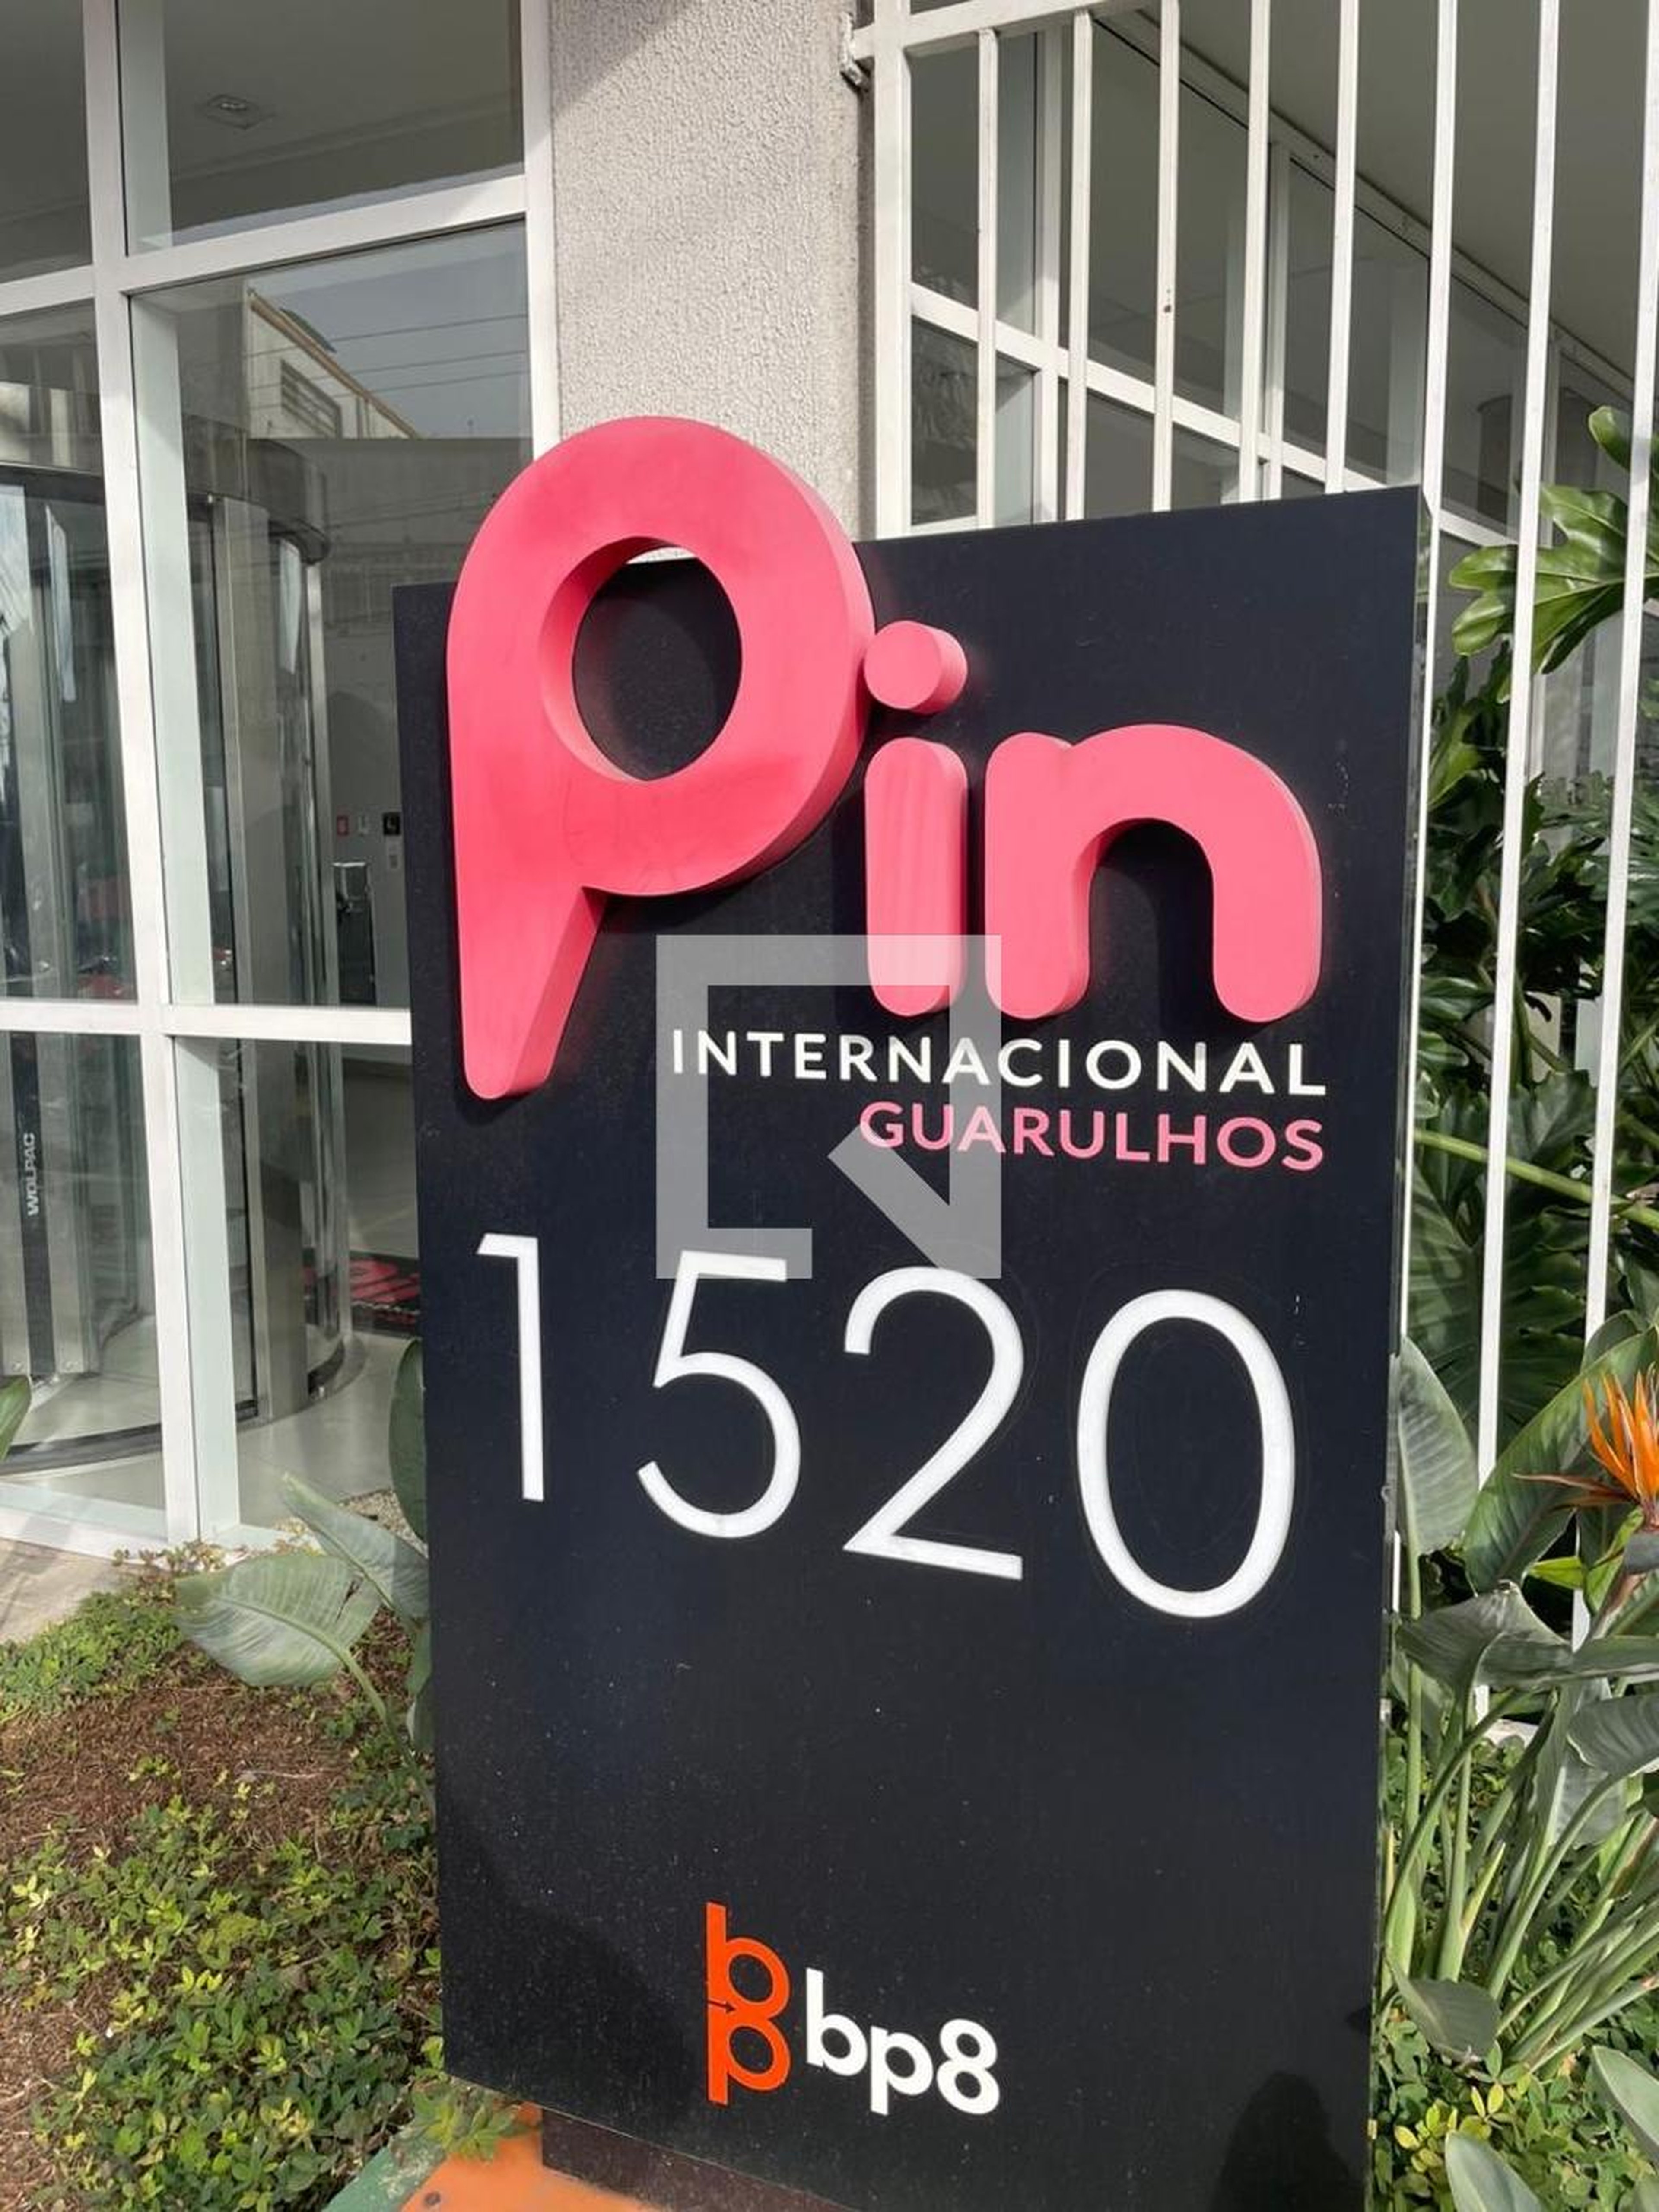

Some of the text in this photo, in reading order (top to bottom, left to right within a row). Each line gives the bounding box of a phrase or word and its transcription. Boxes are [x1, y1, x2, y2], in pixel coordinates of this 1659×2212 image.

[447, 416, 1323, 1099] Pin
[673, 1029, 1326, 1097] INTERNACIONAL
[24, 1133, 39, 1216] WOLPAC
[860, 1101, 1323, 1171] GUARULHOS
[477, 1233, 1295, 1618] 1520
[807, 1967, 1000, 2115] bp8
